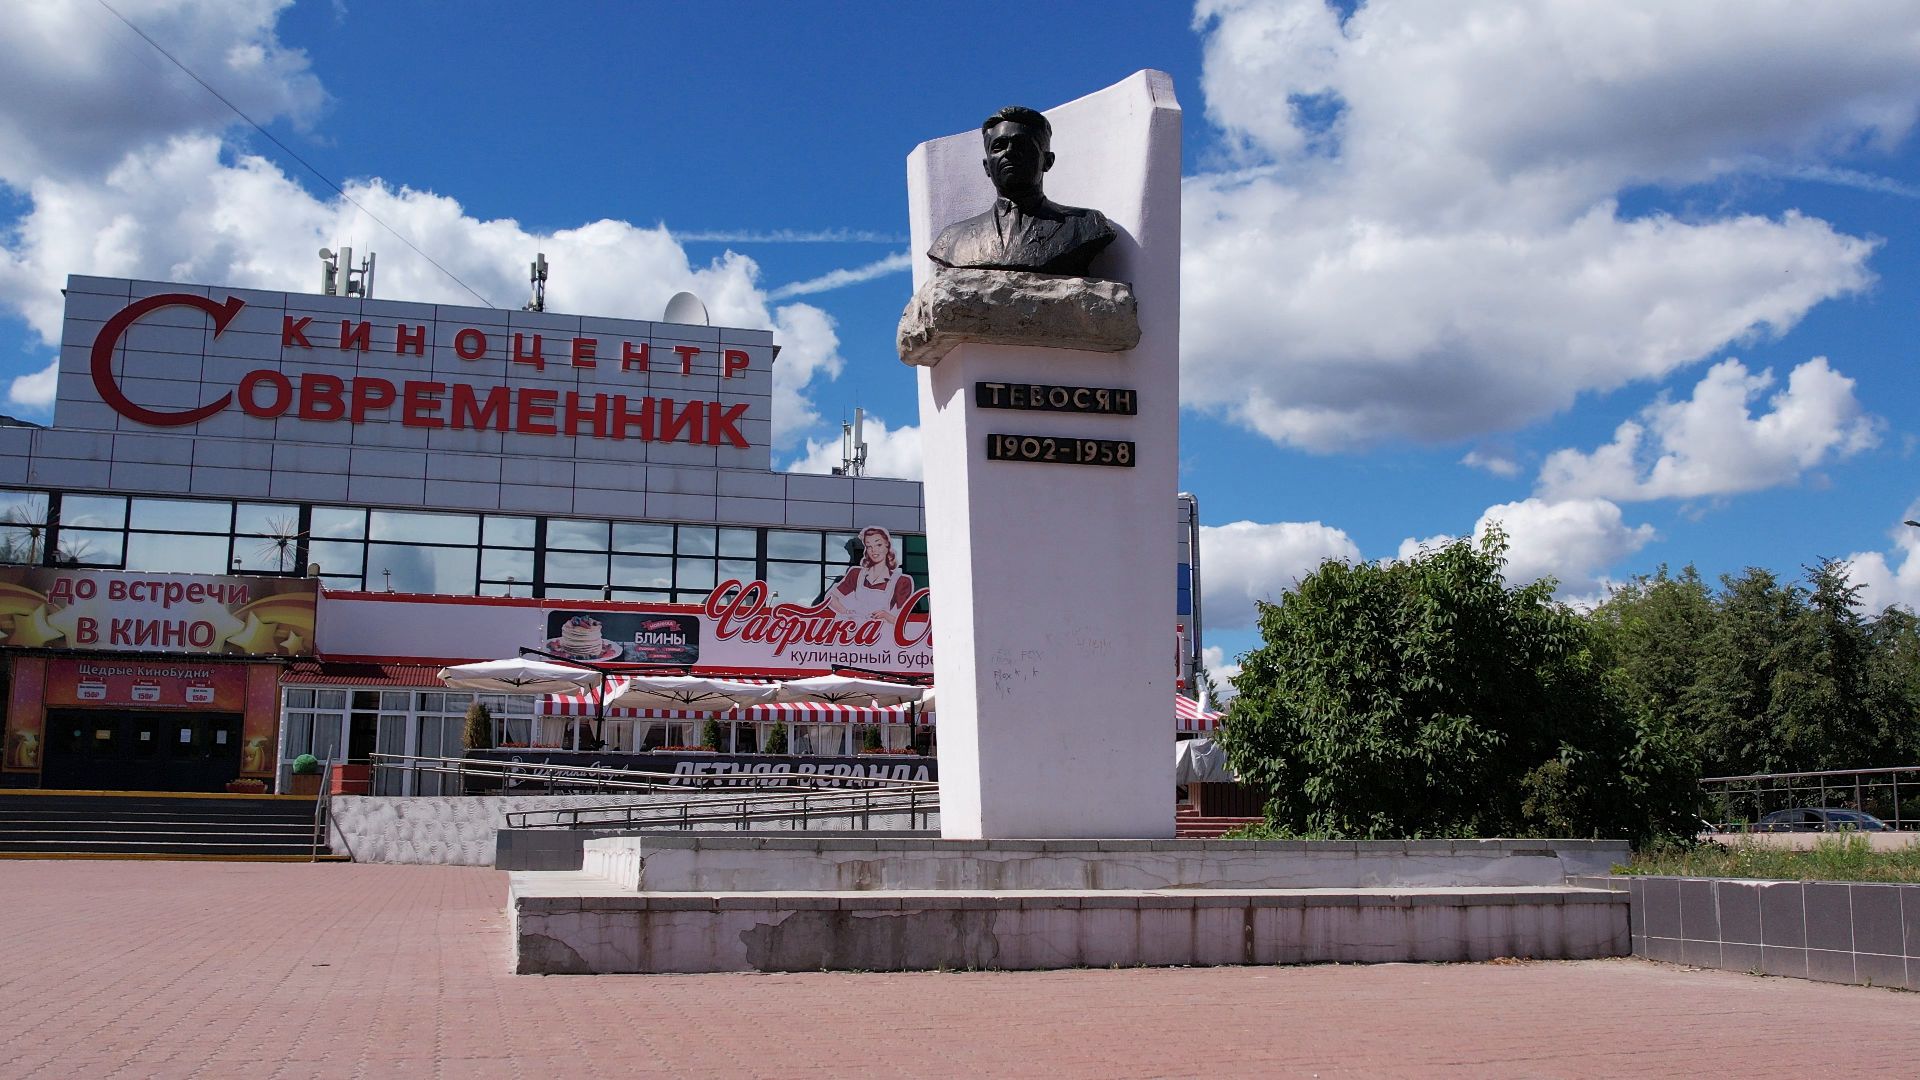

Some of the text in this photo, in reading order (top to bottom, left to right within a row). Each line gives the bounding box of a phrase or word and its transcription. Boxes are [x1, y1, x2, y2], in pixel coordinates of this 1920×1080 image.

[282, 315, 750, 379] КИНОЦЕНТР
[985, 383, 1131, 412] ТЕВОСЯН
[995, 434, 1130, 464] 1902-1958
[108, 579, 250, 609] встречи
[704, 578, 883, 657] Фабрика
[76, 617, 216, 648] В КИНО
[634, 631, 686, 646] БЛИНЫ
[79, 664, 133, 677] Щедрые
[790, 650, 891, 667] кулинарный
[668, 761, 930, 789] ЛЕТНЯЯ ВЕРАНДА
